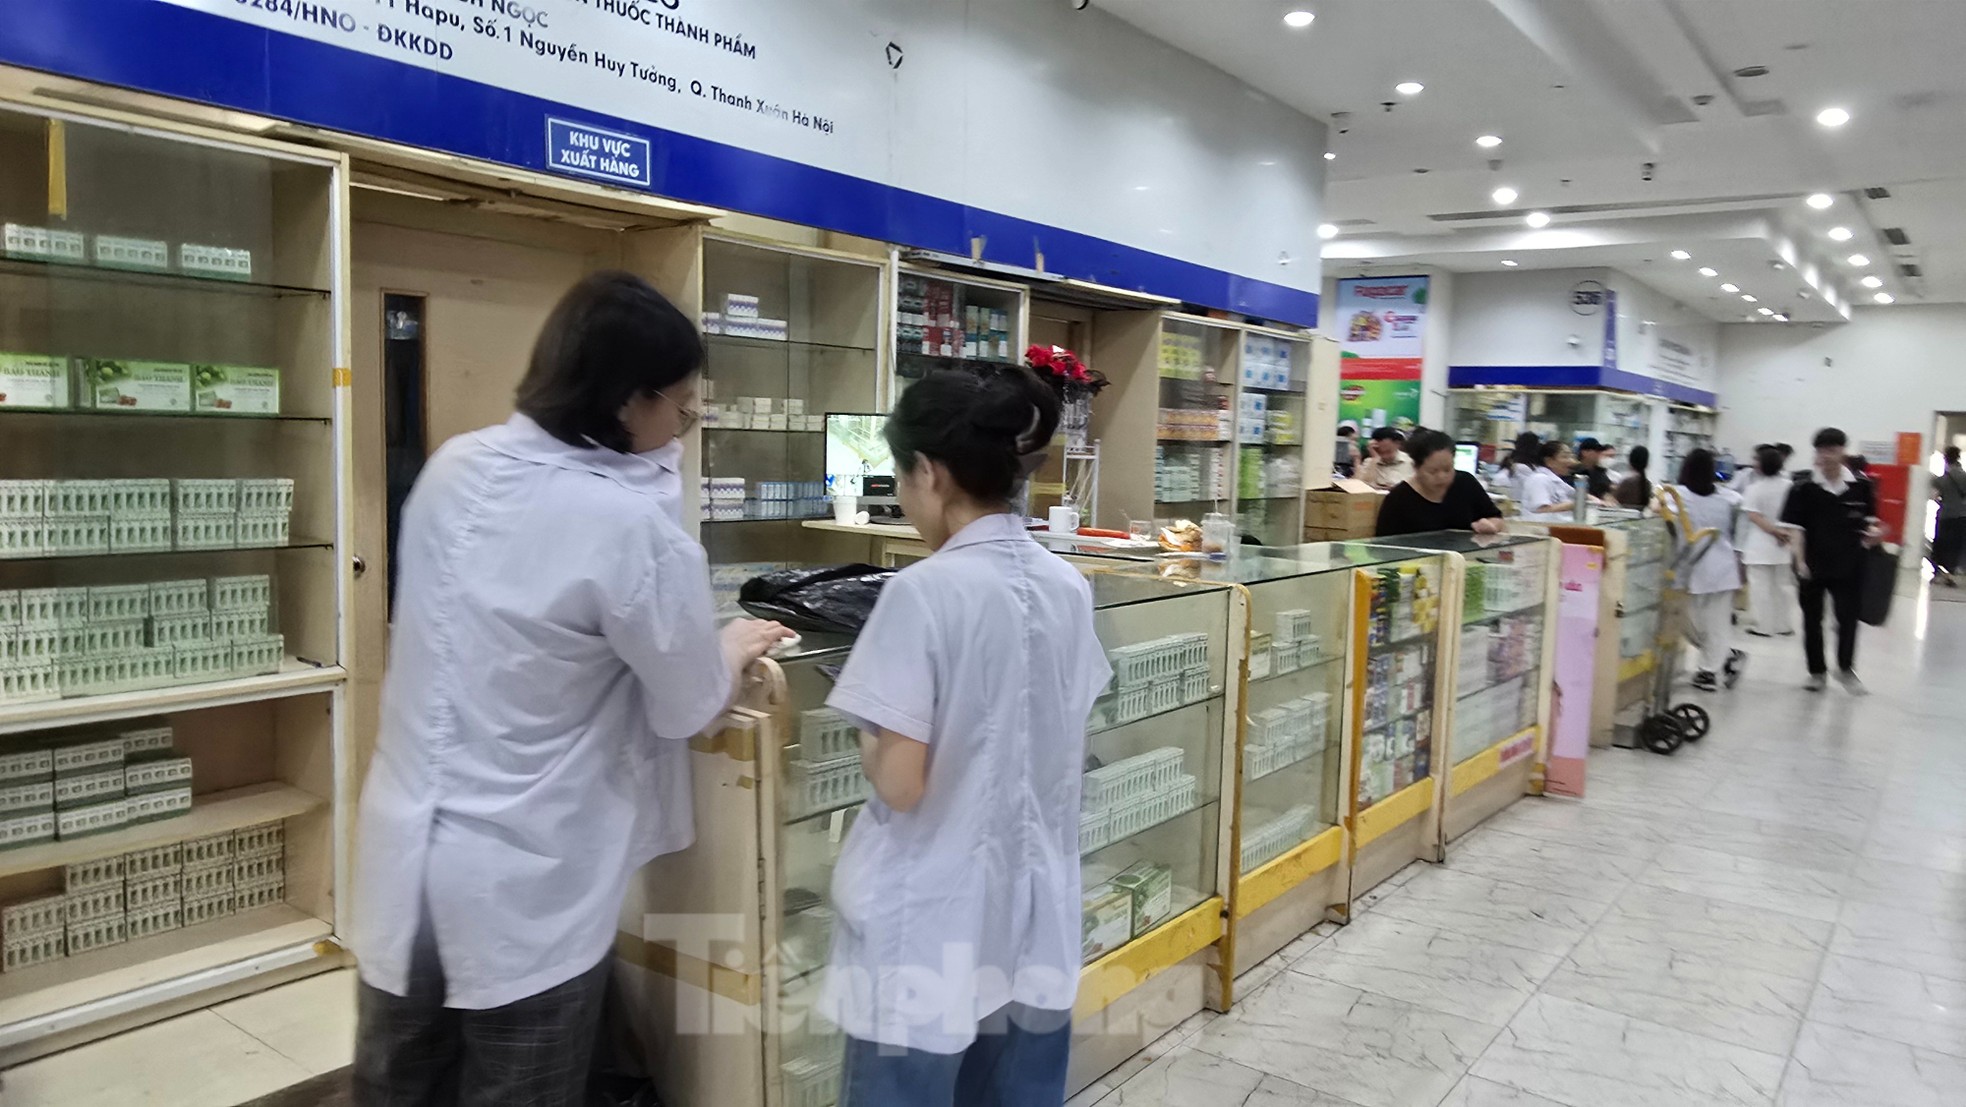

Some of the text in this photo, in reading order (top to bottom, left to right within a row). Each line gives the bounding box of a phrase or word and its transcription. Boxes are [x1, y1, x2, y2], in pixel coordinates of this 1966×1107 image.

[594, 51, 626, 77] Huy
[690, 80, 706, 98] Q.
[711, 85, 752, 110] Thanh
[569, 131, 631, 158] KHU VỰC
[561, 149, 640, 178] XUẤT HÀNG
